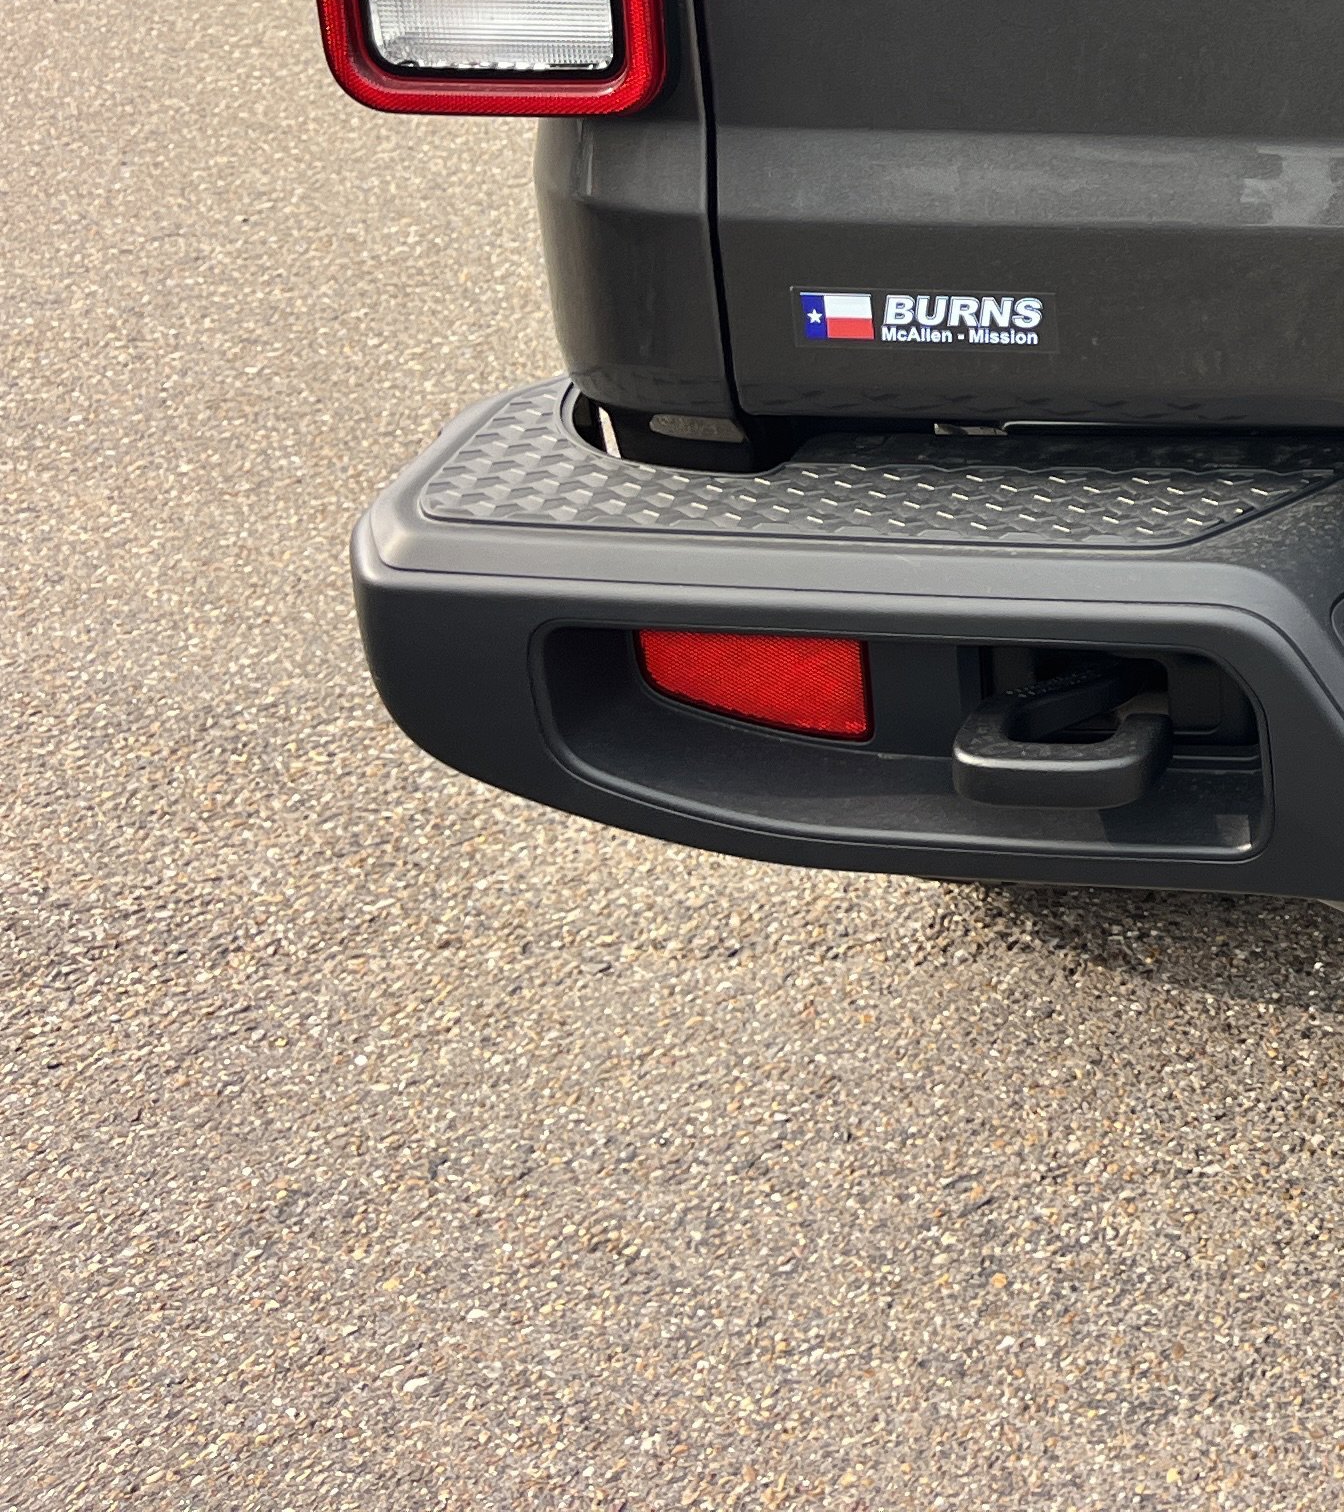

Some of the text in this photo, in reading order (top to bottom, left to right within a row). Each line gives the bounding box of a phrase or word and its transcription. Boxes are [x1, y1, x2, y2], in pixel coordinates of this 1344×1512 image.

[883, 294, 1043, 329] BURNS
[881, 325, 953, 343] McAllen
[968, 327, 1039, 345] Mission
